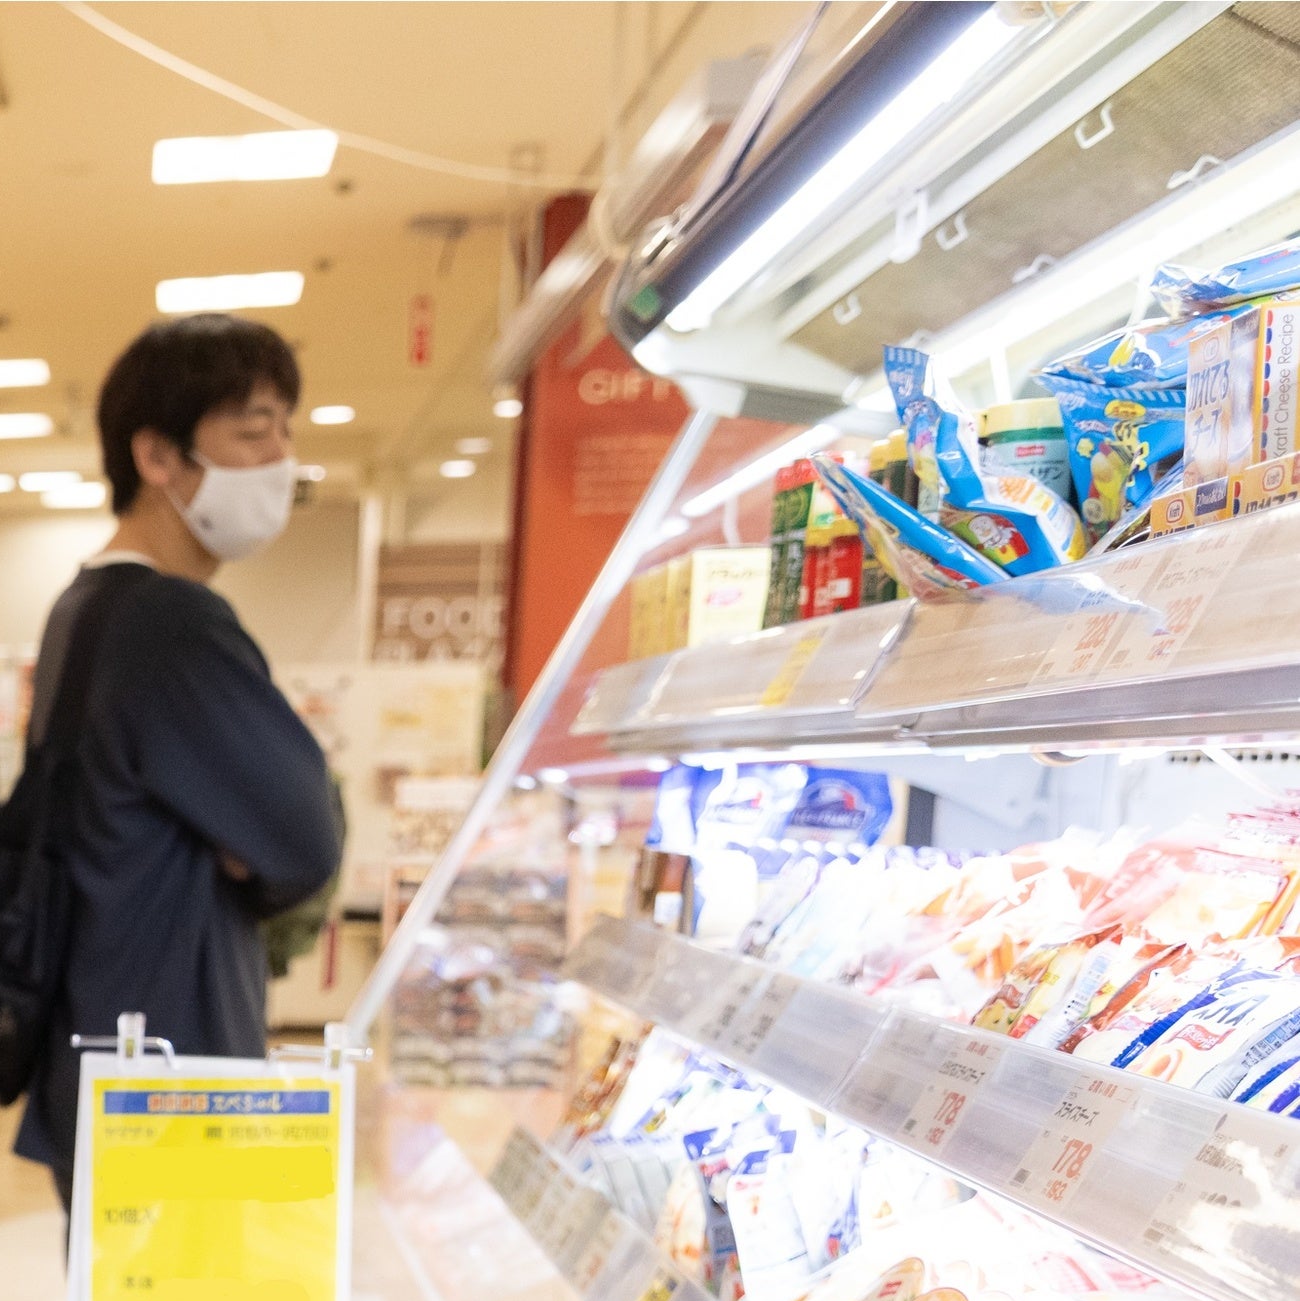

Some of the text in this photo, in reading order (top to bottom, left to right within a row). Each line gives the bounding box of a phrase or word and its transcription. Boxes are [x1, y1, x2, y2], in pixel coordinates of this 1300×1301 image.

[1280, 312, 1295, 364] Recipe
[1274, 367, 1291, 425] Cheese
[933, 1090, 967, 1126] 178
[1054, 1100, 1100, 1128] スライスチーズ
[1051, 1137, 1094, 1179] 178
